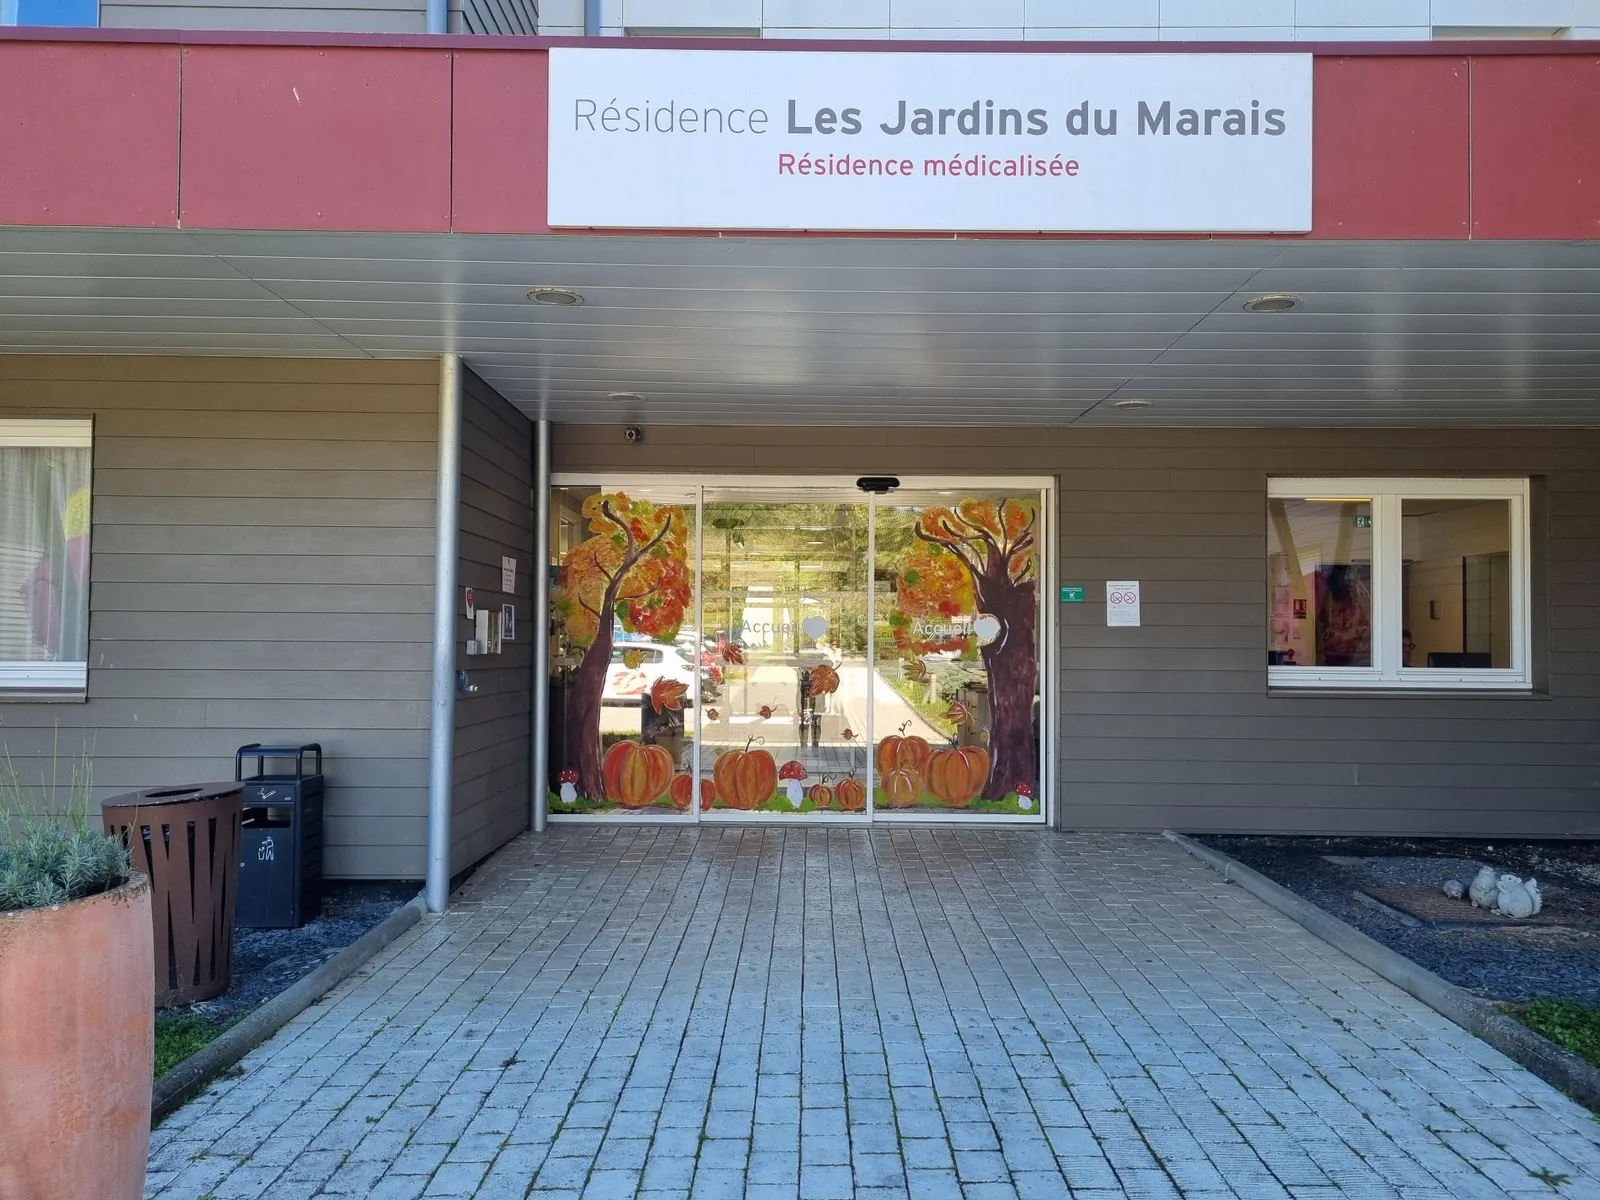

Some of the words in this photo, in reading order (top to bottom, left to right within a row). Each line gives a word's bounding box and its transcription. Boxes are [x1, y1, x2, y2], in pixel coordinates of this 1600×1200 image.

[575, 98, 768, 134] Résidence
[787, 99, 862, 135] Les
[880, 99, 1049, 136] Jardins
[1065, 99, 1117, 136] du
[1138, 100, 1286, 137] Marais
[778, 152, 914, 177] Résidence
[923, 153, 1079, 177] médicalisée
[912, 620, 971, 635] Accueil
